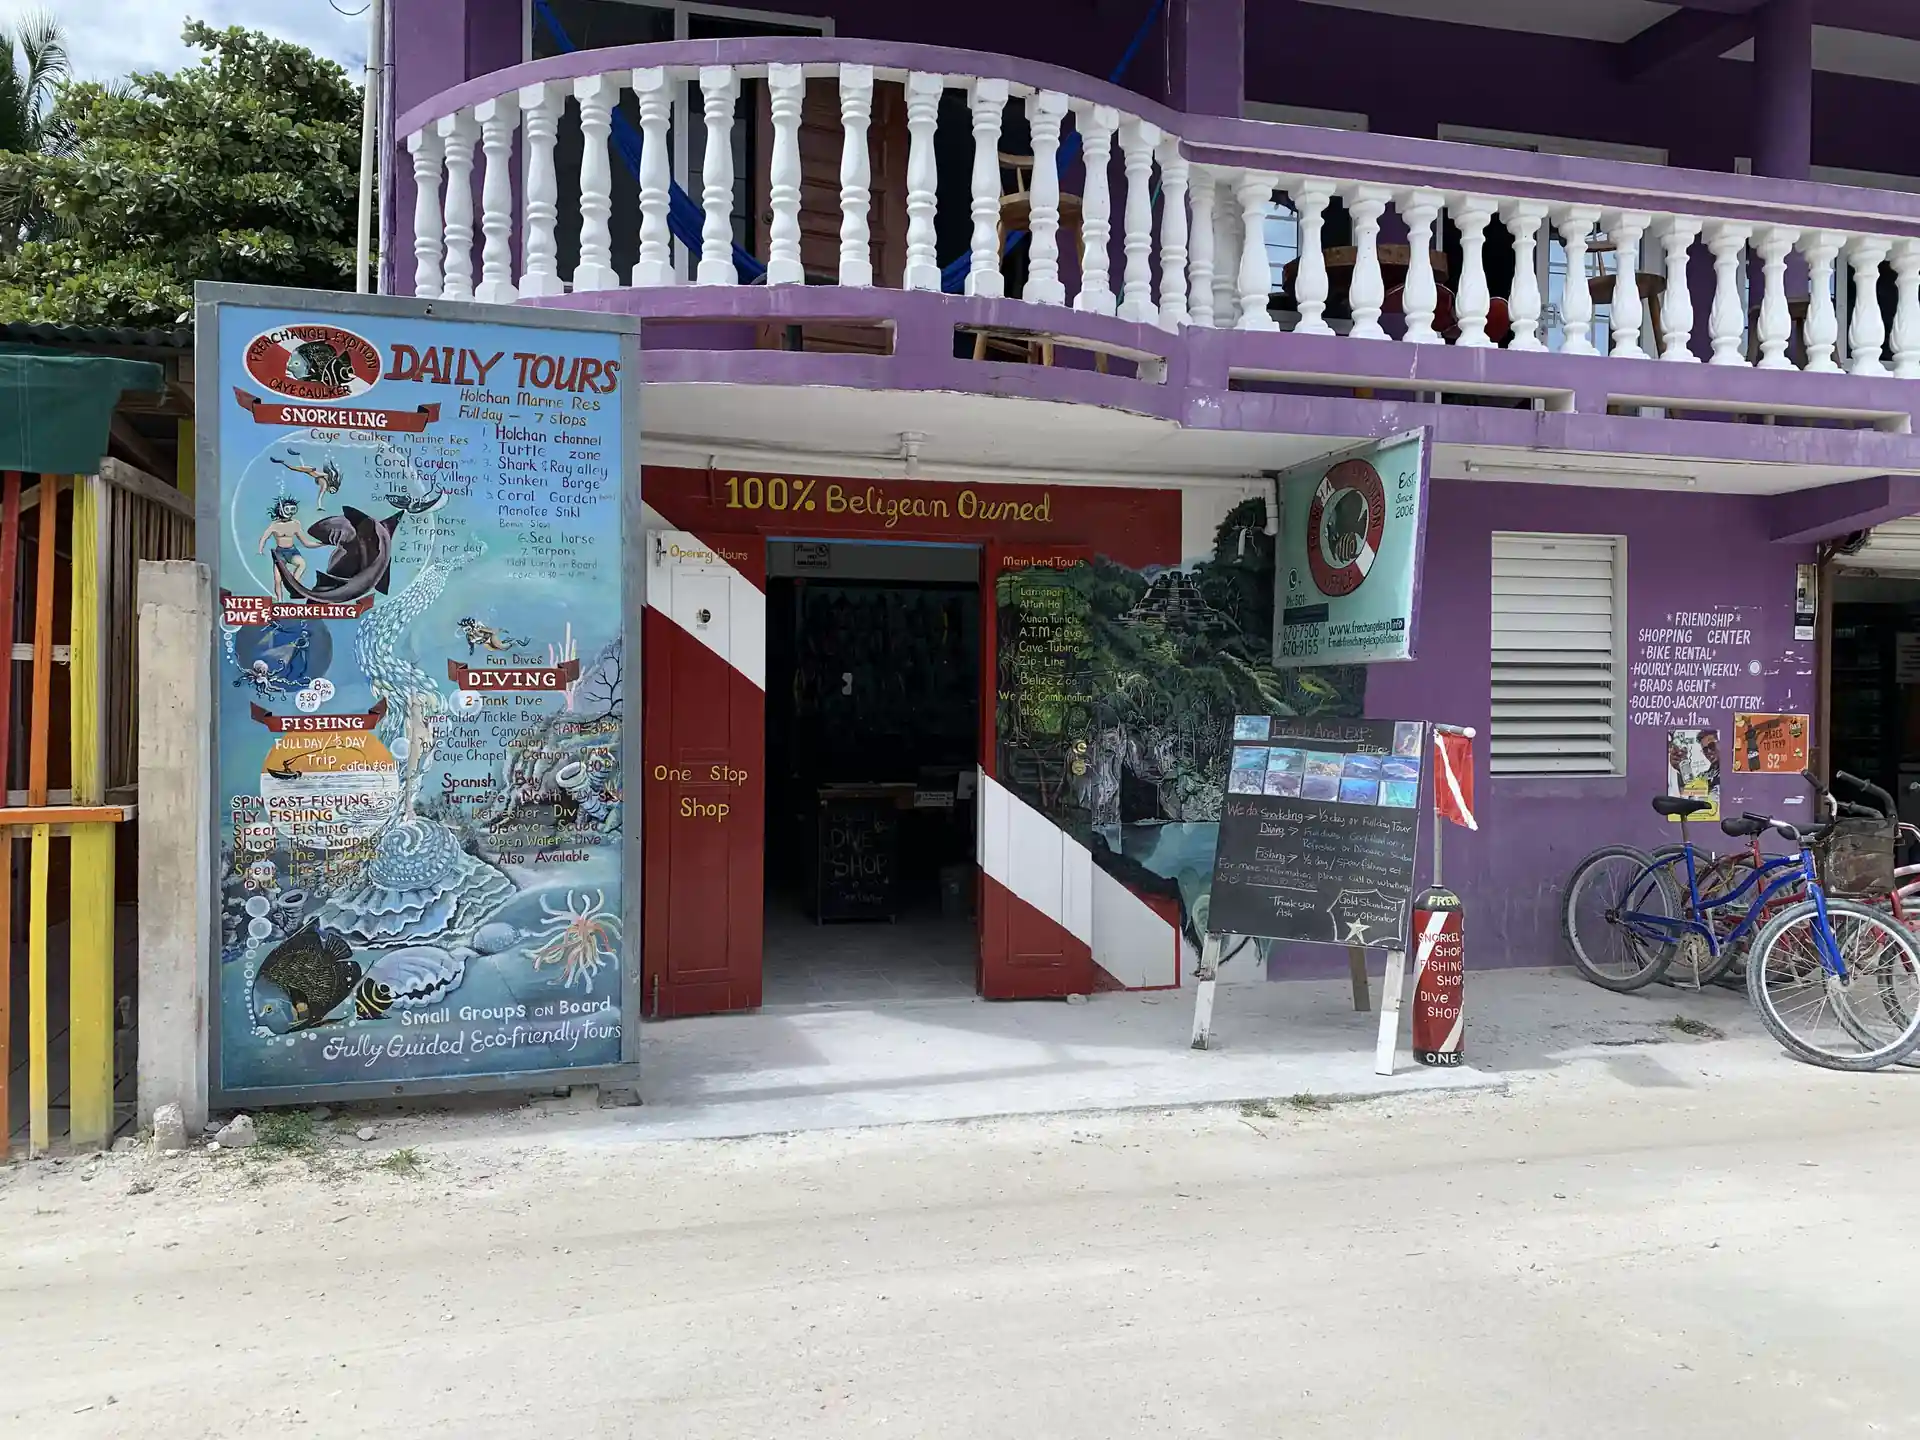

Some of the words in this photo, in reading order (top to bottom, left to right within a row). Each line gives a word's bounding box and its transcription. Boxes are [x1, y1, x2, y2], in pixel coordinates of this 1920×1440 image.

[384, 344, 505, 385] DAILY
[512, 352, 621, 394] TOURS
[269, 378, 300, 394] CAYE
[299, 384, 352, 398] CAULKER
[460, 388, 510, 405] Holchan
[516, 391, 565, 409] Marine
[571, 397, 601, 411] Res
[280, 407, 388, 428] SNORKELING
[549, 411, 587, 427] stops
[310, 428, 341, 444] Caye
[349, 430, 395, 443] Caulker
[403, 433, 445, 445] Marine
[495, 424, 547, 443] Holchan
[554, 431, 602, 446] channel
[388, 444, 412, 459] day
[498, 442, 548, 457] Turtle
[569, 450, 601, 460] zone
[374, 456, 410, 468] Coral
[414, 455, 459, 470] Garden
[498, 456, 538, 472] Shark
[550, 460, 573, 478] Ray
[577, 464, 608, 480] alley
[374, 468, 409, 480] Shark
[416, 469, 437, 485] Ray
[440, 471, 479, 487] Village
[499, 473, 548, 488] Sunken
[562, 476, 601, 493] Barge
[385, 481, 408, 493] The
[497, 489, 535, 502] Coral
[549, 492, 597, 504] Garden
[724, 477, 817, 512] 100%
[826, 485, 952, 528] Belizean
[957, 490, 1054, 523] Owned
[1395, 504, 1415, 519] 2006
[409, 515, 430, 525] Sea
[437, 514, 468, 526] horse
[529, 531, 552, 545] Sea
[560, 531, 596, 545] horse
[670, 544, 714, 564] Opening
[716, 548, 748, 561] Hours
[1003, 556, 1029, 567] Main
[1031, 556, 1053, 567] Land
[1055, 556, 1085, 568] Tours
[224, 598, 264, 610] NITE
[226, 610, 258, 623] DIVE
[272, 606, 357, 618] SNORKELING
[1674, 612, 1735, 628] FRIENDSHIP
[1638, 628, 1693, 644] SHOPPING
[1707, 630, 1751, 645] CENTER
[486, 654, 507, 666] Fun
[512, 654, 543, 665] Dives
[1646, 646, 1670, 661] BIKE
[1674, 646, 1712, 660] RENTAL
[1044, 656, 1065, 667] Line
[467, 671, 557, 687] DIVING
[1639, 679, 1673, 693] BRADS
[1676, 680, 1711, 693] AGENT
[515, 695, 543, 706] Dive
[281, 717, 365, 732] FISHING
[521, 713, 544, 723] Box
[491, 726, 535, 741] Canyon
[275, 738, 301, 750] FULL
[345, 736, 367, 749] DAY
[447, 737, 488, 748] Caulker
[307, 754, 338, 770] Trip
[433, 750, 464, 765] Caye
[466, 750, 507, 767] Chapel
[521, 750, 570, 764] Canyon
[441, 772, 497, 793] Spanish
[654, 765, 692, 781] One
[710, 765, 749, 787] Stop
[231, 795, 265, 809] SPIN
[269, 796, 306, 808] CAST
[311, 794, 370, 808] FISHING
[232, 810, 260, 823] FLY
[269, 810, 333, 822] FISHING
[680, 797, 731, 823] Shop
[232, 825, 278, 838] Spear
[1260, 821, 1286, 838] Diving
[1392, 820, 1412, 833] Tour
[526, 834, 562, 847] Water
[498, 853, 525, 866] Also
[535, 851, 590, 864] Available
[1255, 846, 1286, 865] Fishing
[1275, 908, 1293, 918] Ash
[1418, 932, 1460, 943] SNORKEL
[1434, 945, 1462, 957] SHOP
[1420, 960, 1463, 972] FISHING
[1436, 975, 1463, 987] SHOP
[402, 1005, 450, 1026] Small
[459, 1003, 527, 1024] Groups
[559, 996, 611, 1015] Board
[1427, 1006, 1460, 1020] SHOP
[322, 1035, 385, 1067] Fully
[387, 1031, 465, 1058] Guided
[1426, 1052, 1458, 1064] ONE
